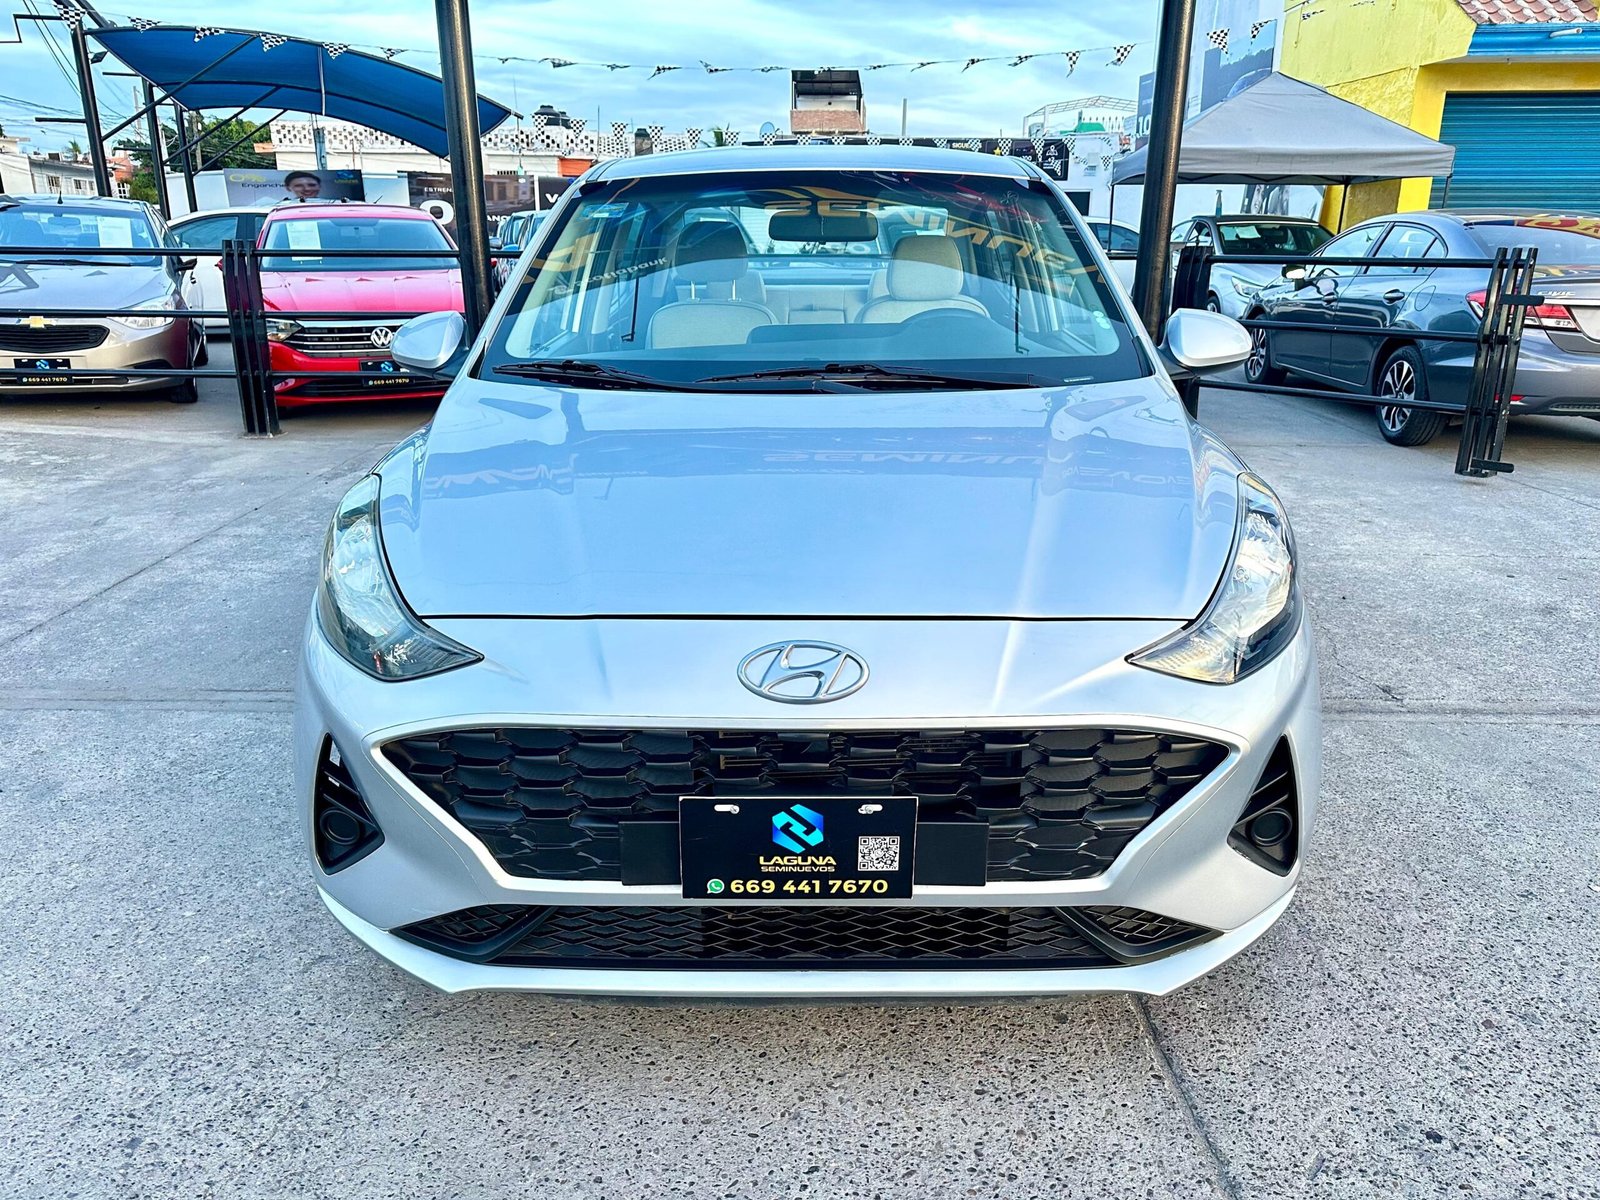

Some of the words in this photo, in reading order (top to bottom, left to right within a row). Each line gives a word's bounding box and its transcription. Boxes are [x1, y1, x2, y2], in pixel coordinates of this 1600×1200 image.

[759, 856, 837, 866] LAGUNA
[730, 879, 776, 894] 669
[782, 879, 820, 894] 441
[828, 879, 889, 894] 7670
